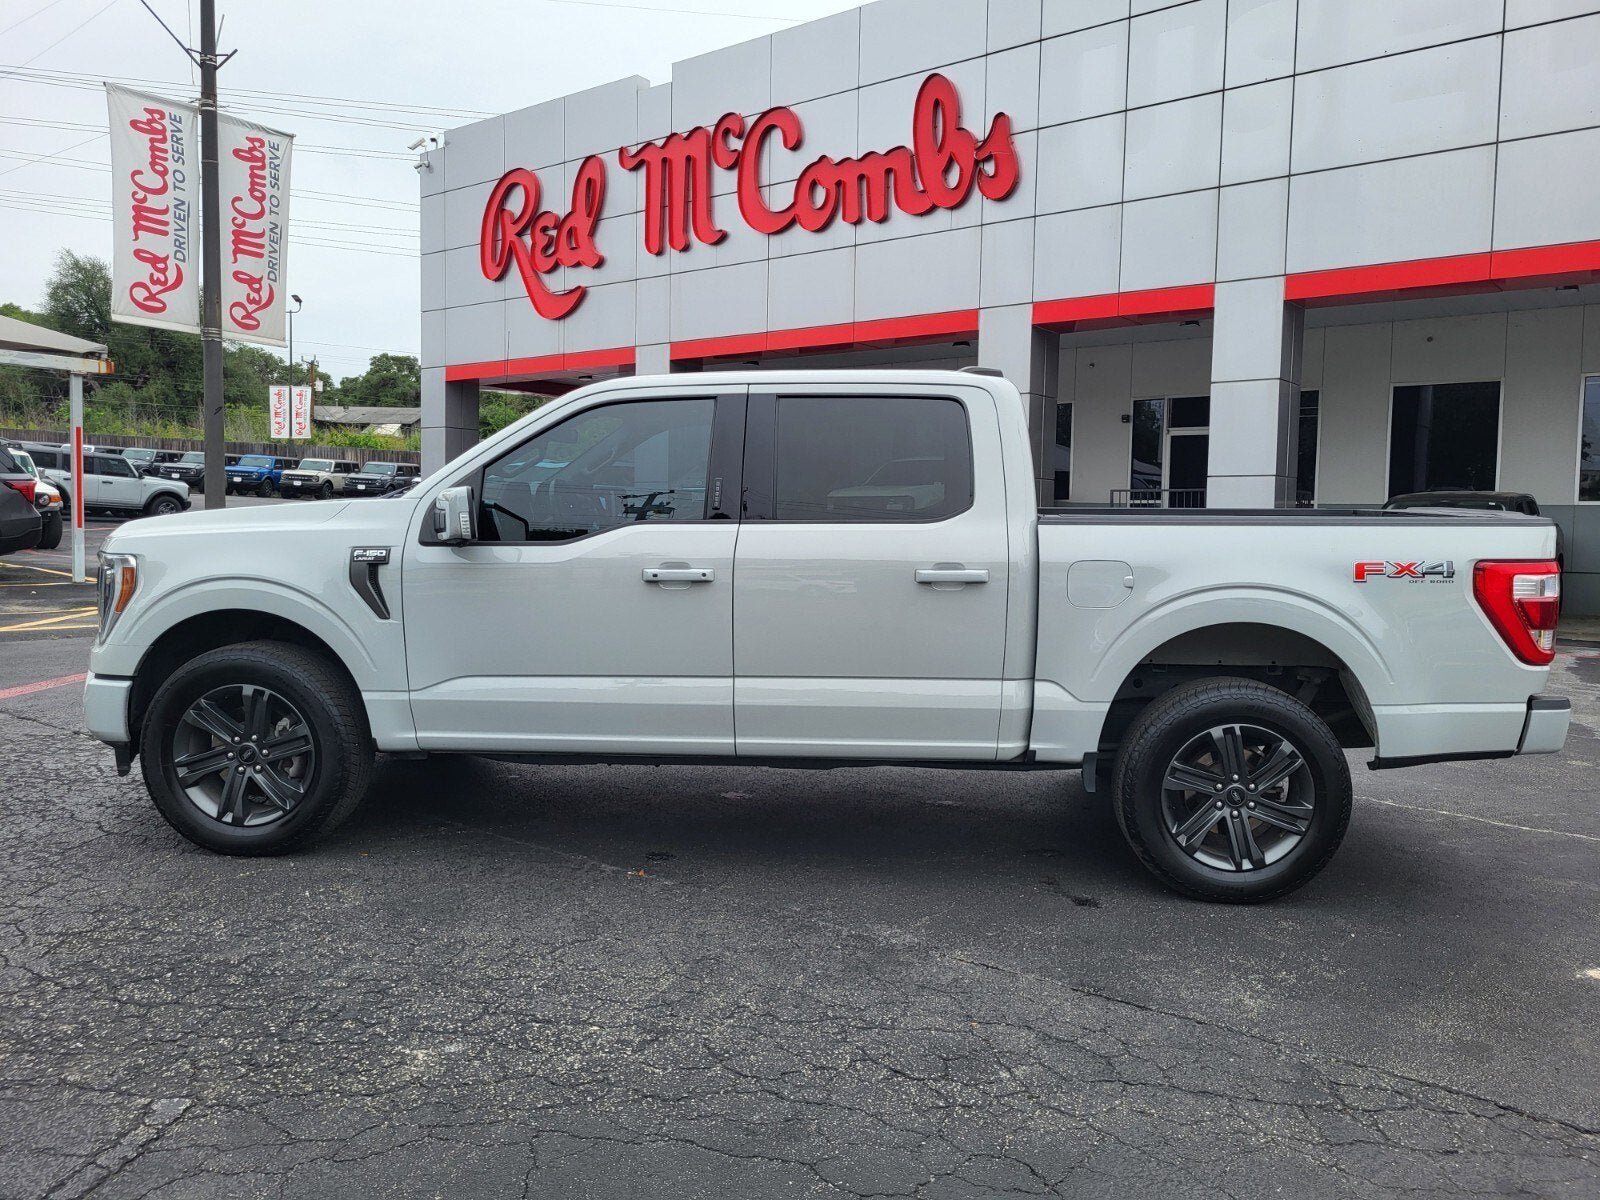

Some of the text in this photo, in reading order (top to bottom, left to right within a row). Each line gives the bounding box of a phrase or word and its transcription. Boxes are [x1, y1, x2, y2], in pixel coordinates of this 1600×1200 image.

[129, 107, 184, 314] Red McCombs
[169, 112, 187, 263] DRIVEN TO SERVE
[229, 136, 275, 331] Red McCombs
[267, 140, 281, 284] DRIVEN TO SERVE
[480, 72, 1020, 320] Red McCombs
[1353, 560, 1455, 583] FX4
